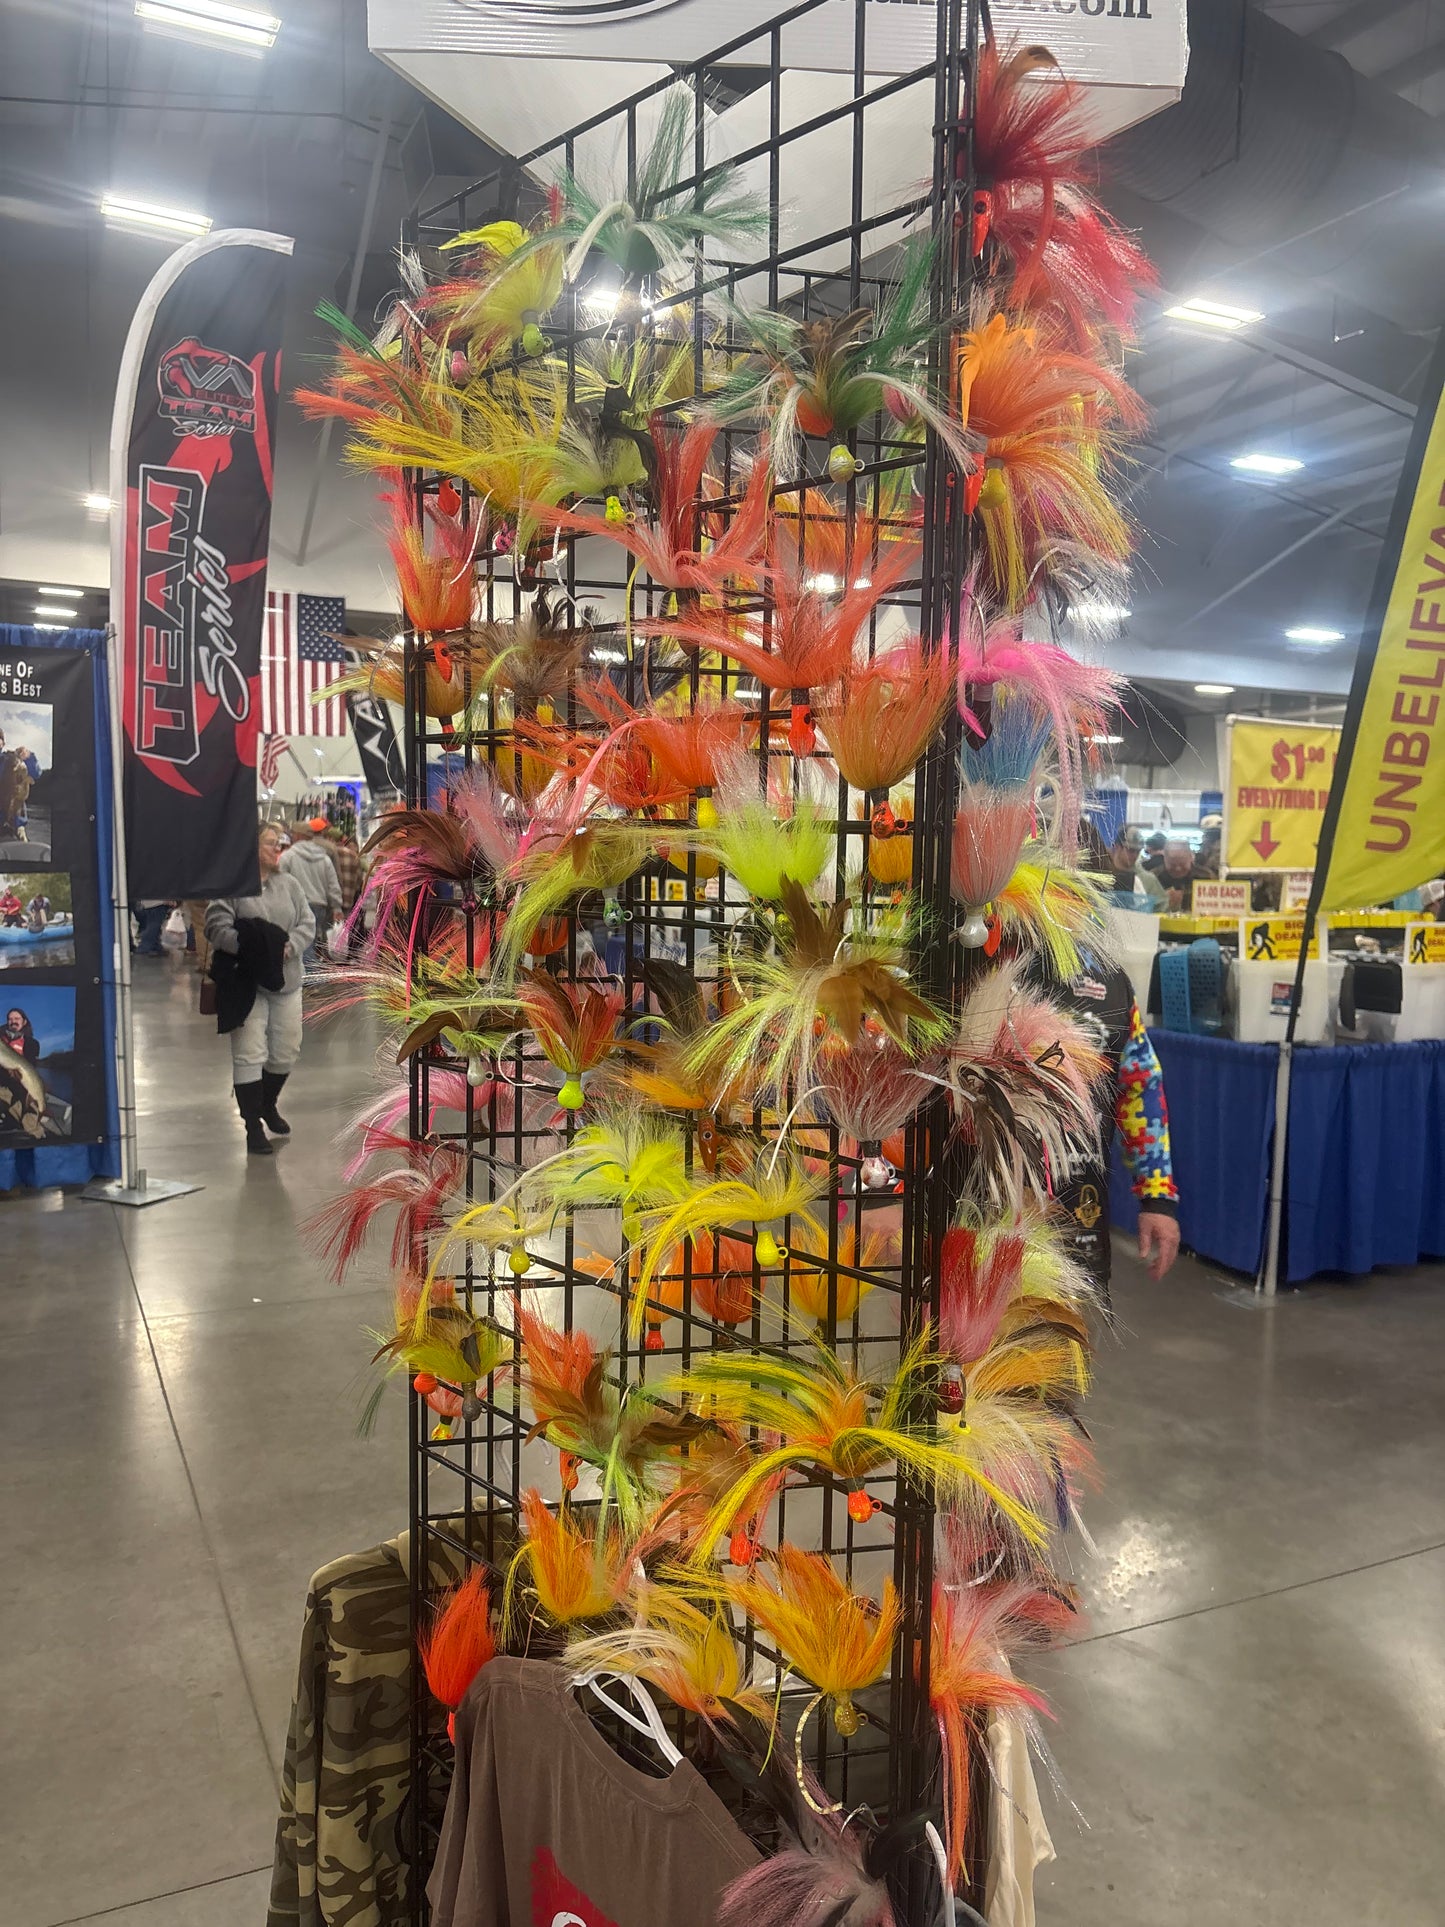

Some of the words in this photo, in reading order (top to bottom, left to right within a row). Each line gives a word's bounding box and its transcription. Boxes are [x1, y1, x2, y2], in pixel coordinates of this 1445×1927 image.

[163, 397, 253, 428] TEAM
[172, 420, 236, 436] Series
[140, 474, 194, 750] TEAM
[186, 533, 251, 722] Series
[1364, 481, 1445, 854] UNBELIEV
[13, 678, 42, 697] BEST
[1237, 786, 1315, 811] EVERYTHING
